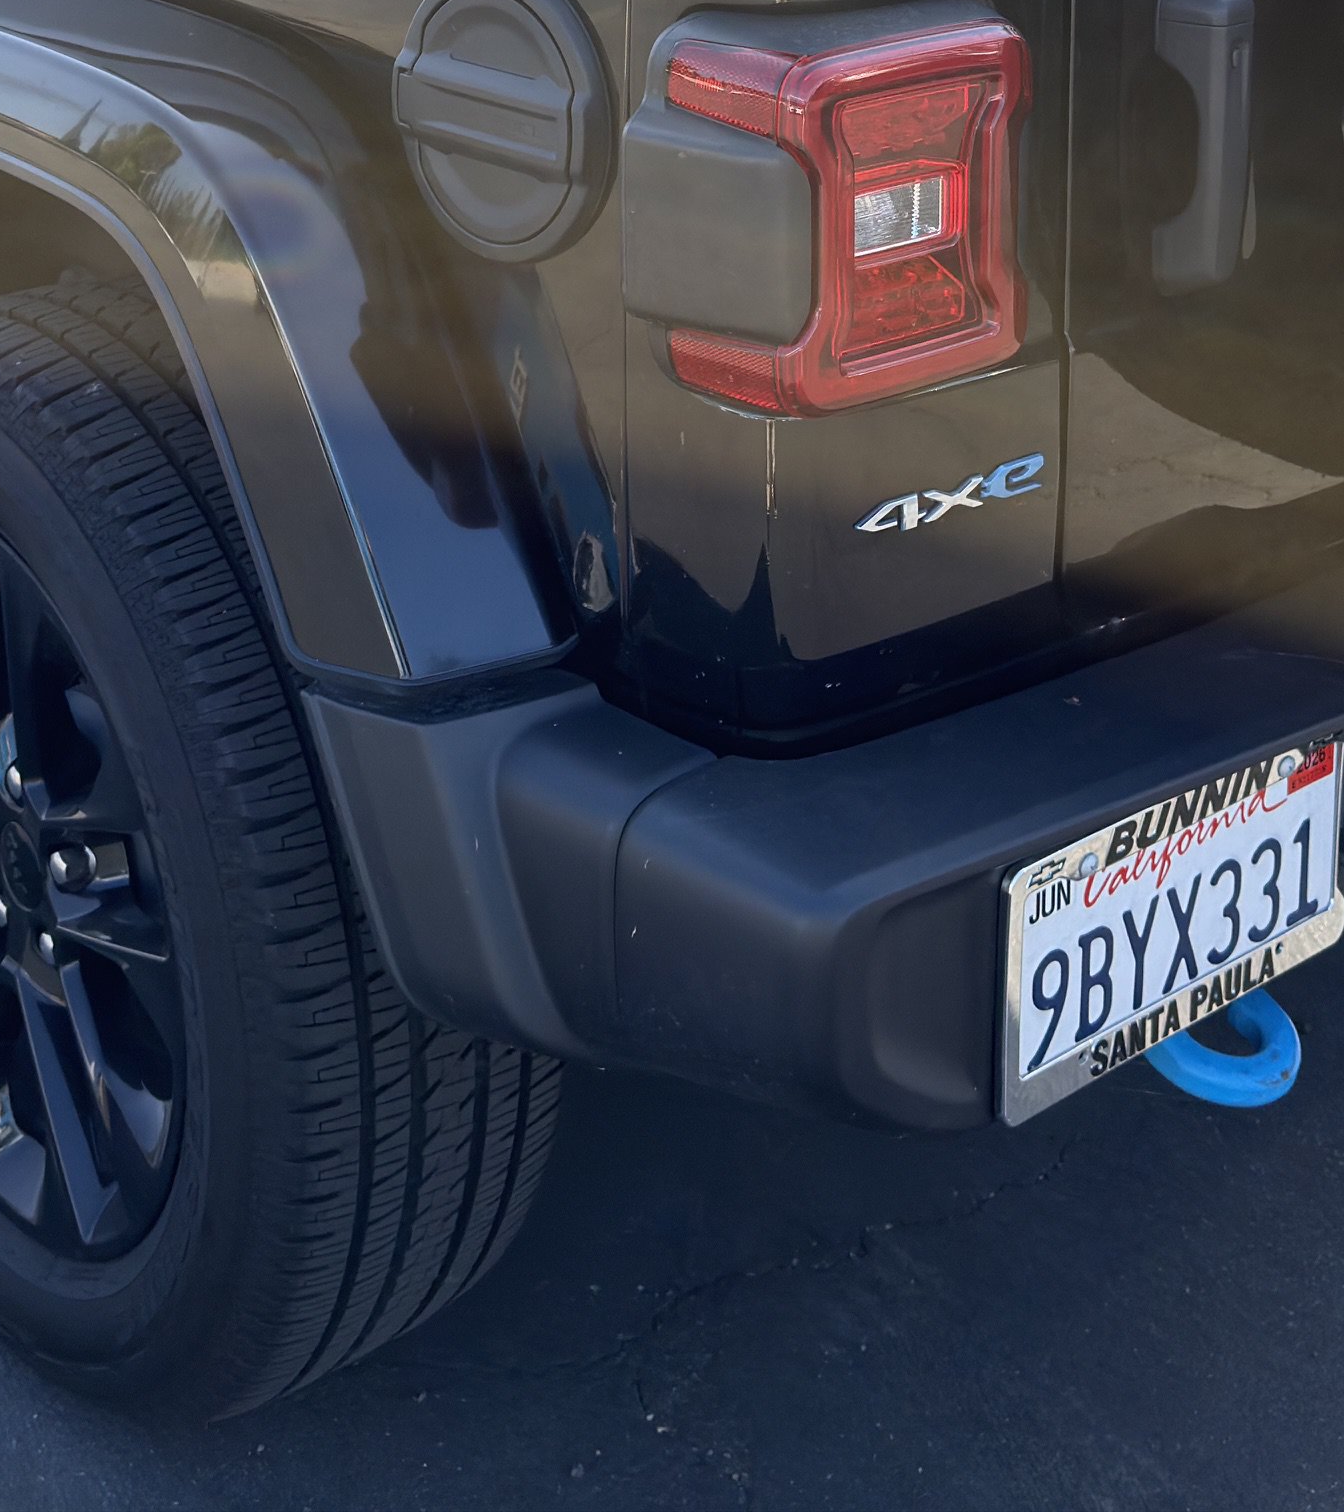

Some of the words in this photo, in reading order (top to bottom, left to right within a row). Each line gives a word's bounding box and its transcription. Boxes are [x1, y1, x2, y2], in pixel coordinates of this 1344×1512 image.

[1082, 784, 1288, 908] California
[1105, 758, 1275, 866] BUNNIN
[1027, 817, 1319, 1073] 9BYX331
[1029, 879, 1071, 925] JUN
[1089, 1005, 1180, 1077] SANTA
[1190, 947, 1275, 1023] PAULA
